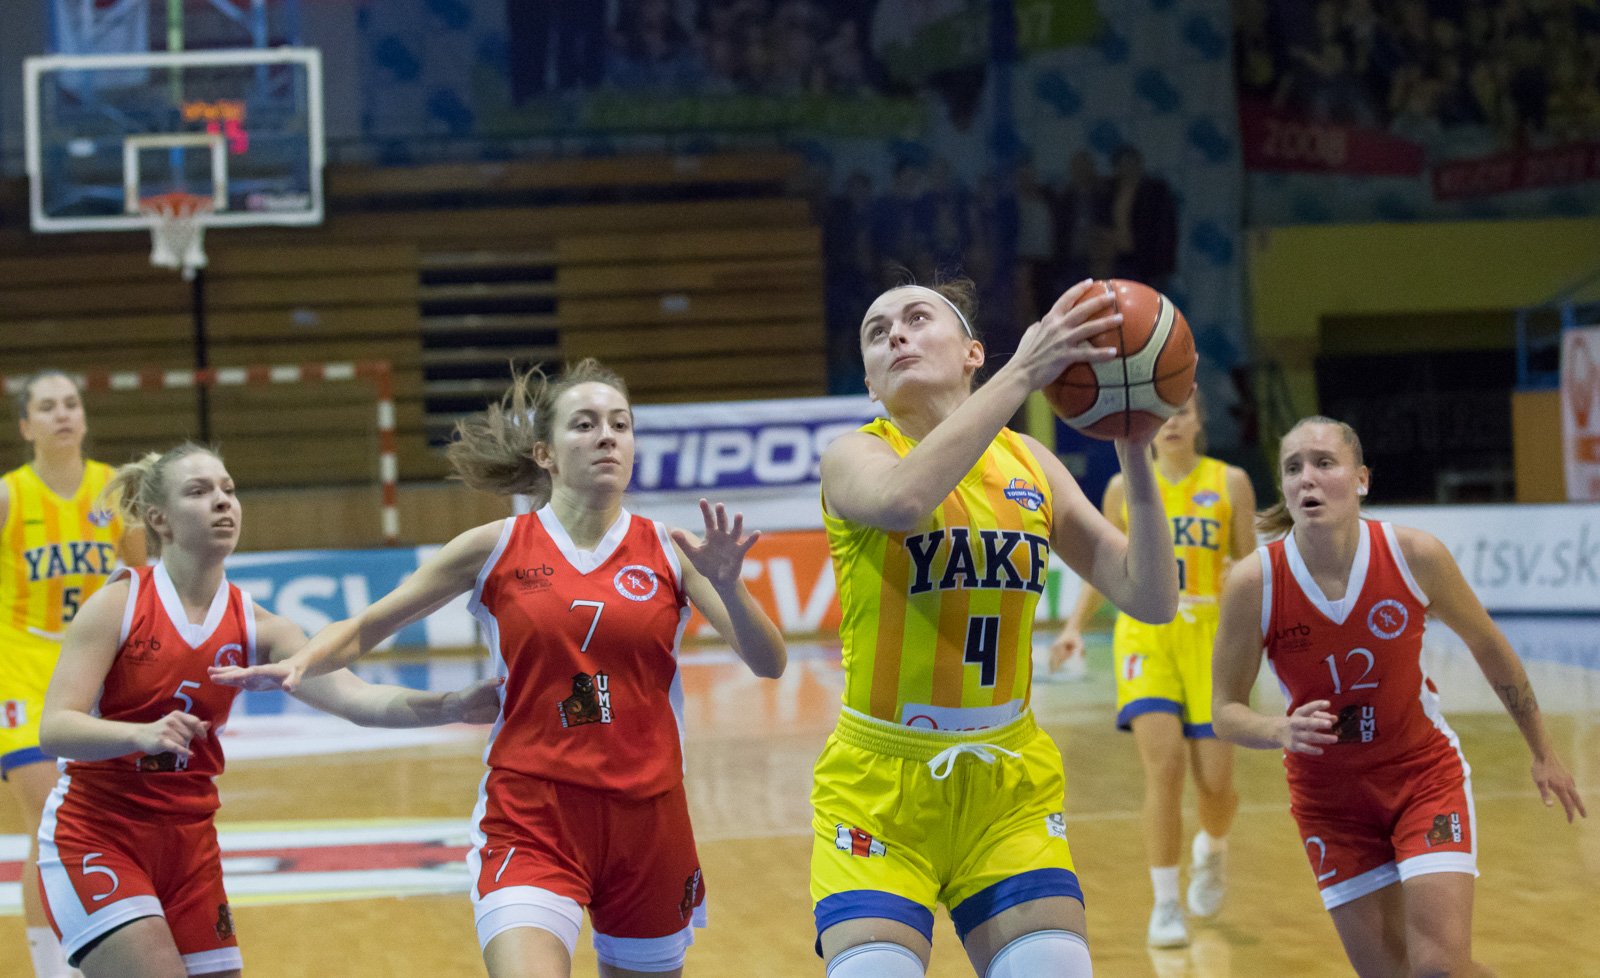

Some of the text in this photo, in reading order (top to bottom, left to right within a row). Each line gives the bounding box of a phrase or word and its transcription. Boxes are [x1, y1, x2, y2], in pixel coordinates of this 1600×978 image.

[24, 541, 114, 582] YAKE
[515, 563, 554, 579] umb
[905, 527, 1049, 595] YAKE
[62, 587, 81, 623] 5
[569, 599, 605, 653] 7
[963, 615, 1001, 688] 4
[1323, 647, 1379, 694] 12
[172, 680, 201, 713] 5
[596, 674, 611, 723] UMB
[1360, 705, 1375, 743] UMB
[83, 852, 119, 901] 5
